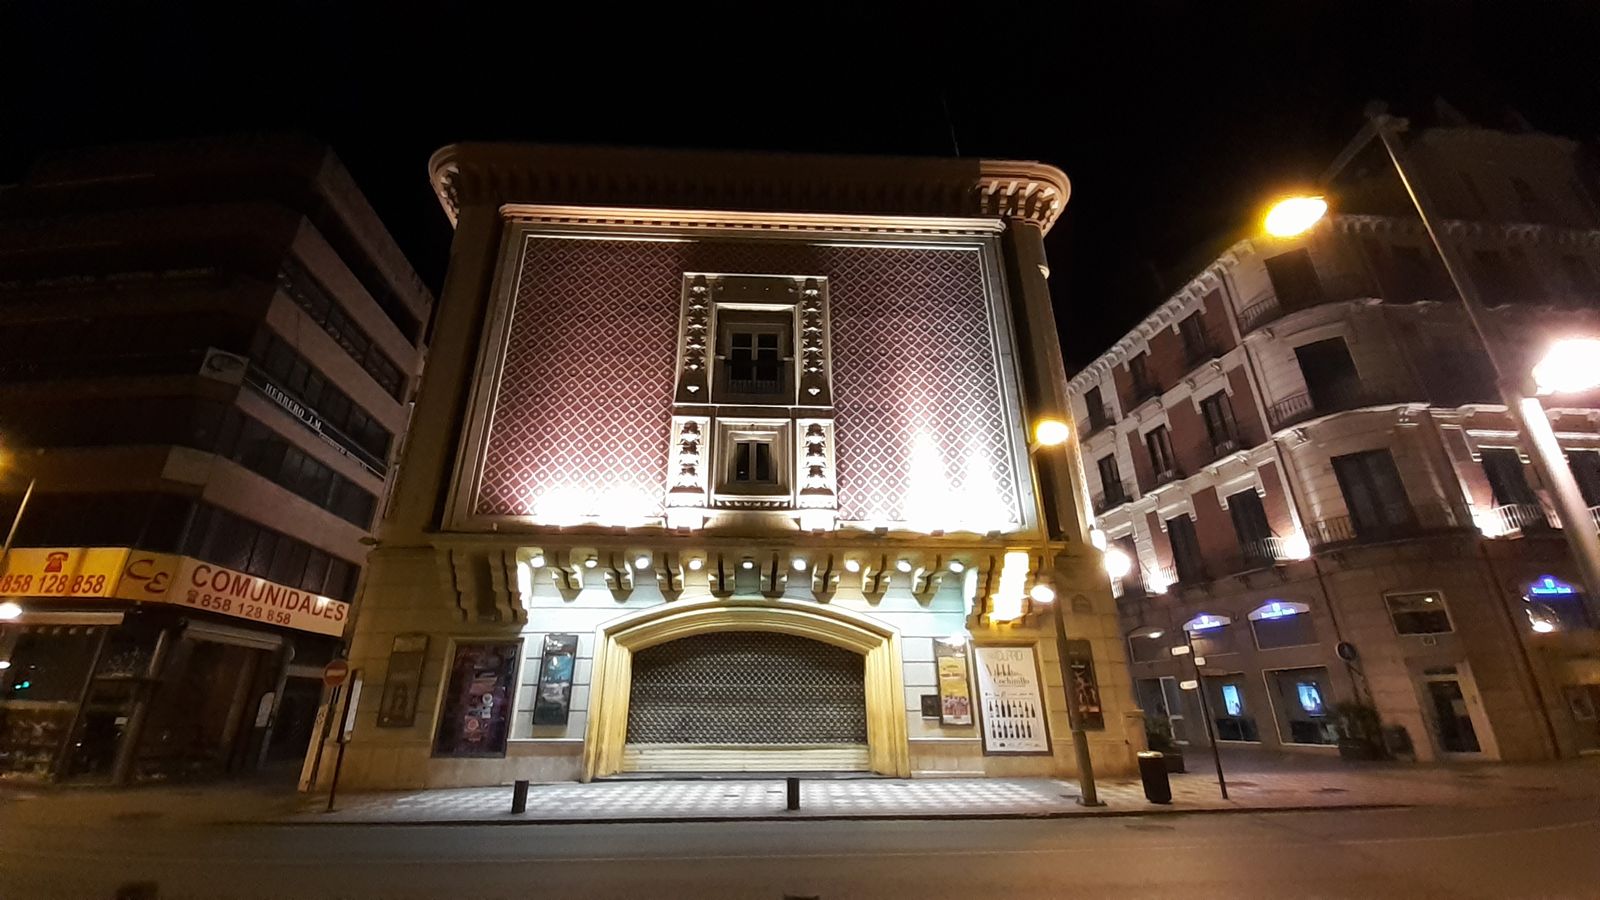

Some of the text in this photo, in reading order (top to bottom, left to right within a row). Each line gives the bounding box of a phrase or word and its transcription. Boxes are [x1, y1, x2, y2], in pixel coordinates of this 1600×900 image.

[265, 383, 305, 418] HERRERO
[2, 574, 106, 594] 858 128 858
[191, 564, 345, 621] COMUNIDADES
[201, 594, 292, 625] 858 128 858
